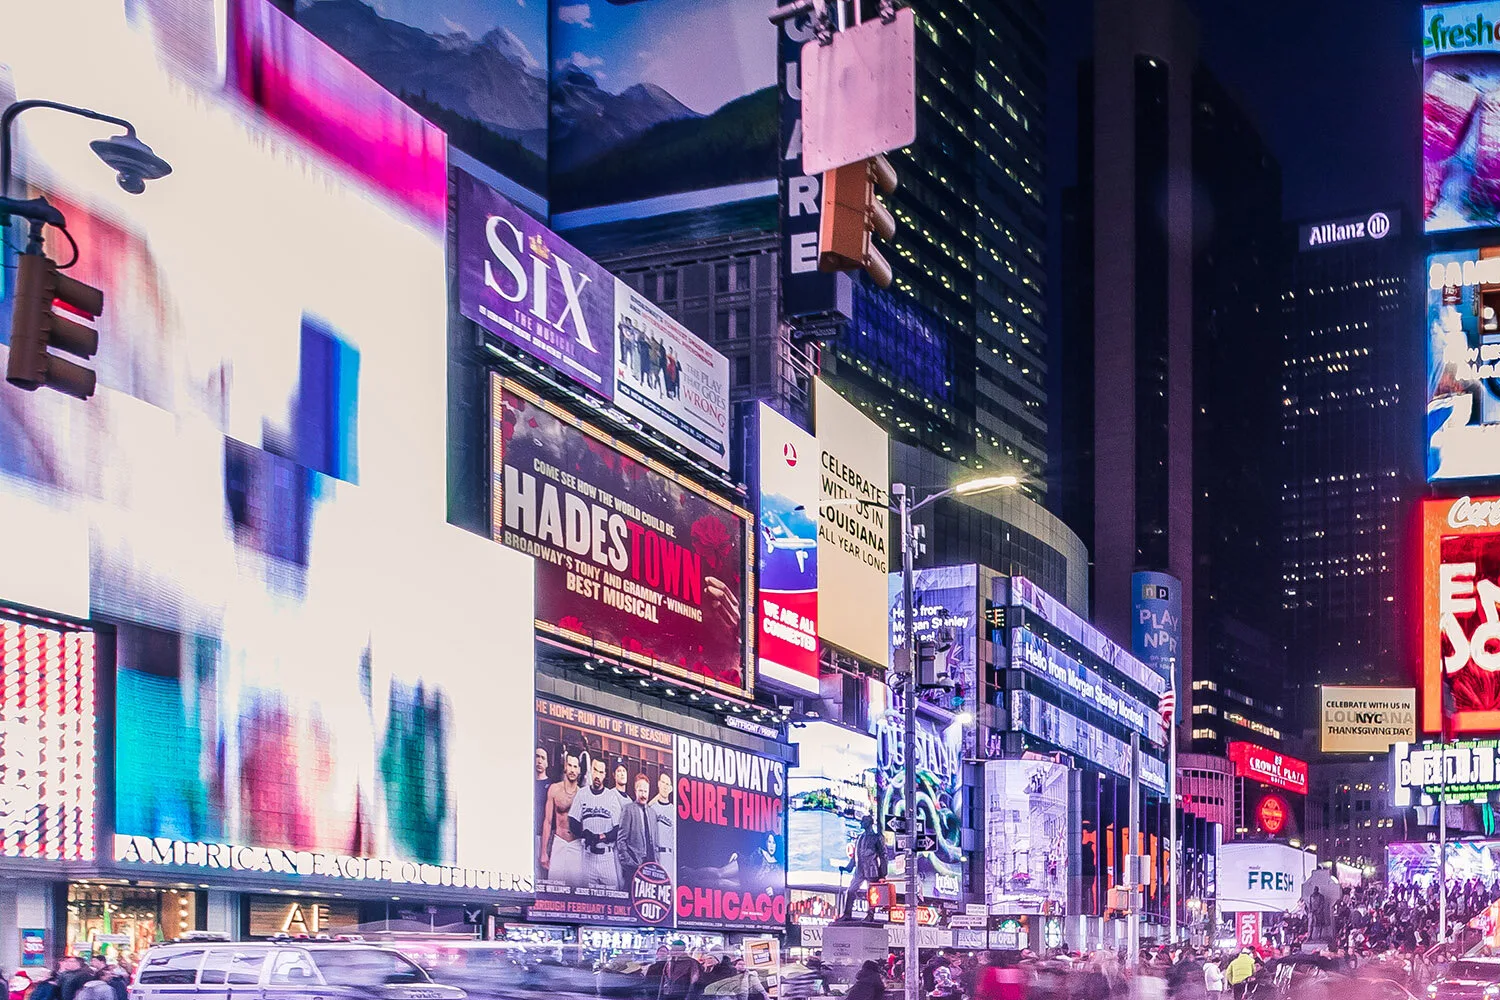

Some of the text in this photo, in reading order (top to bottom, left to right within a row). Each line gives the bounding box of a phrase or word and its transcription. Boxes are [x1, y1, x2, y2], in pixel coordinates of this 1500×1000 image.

[1309, 222, 1365, 246] Allianz
[484, 216, 599, 354] SIX
[683, 385, 727, 428] WRONG
[821, 450, 882, 504] CELEBRATE
[533, 458, 560, 482] COME
[560, 471, 577, 490] SEE
[577, 478, 597, 499] HOW
[598, 488, 614, 508] THE
[614, 497, 641, 521] WORLD
[641, 511, 665, 533] COULD
[504, 464, 702, 606] HADESTOWN
[819, 505, 886, 555] LOUISIANA
[872, 508, 884, 529] IN
[505, 531, 574, 570] BROADWAY'S
[574, 558, 601, 581] TONY
[603, 571, 622, 590] AND
[819, 524, 886, 574] ALL YEAR LONG
[566, 571, 659, 624] BEST MUSICAL
[763, 599, 816, 635] WE ARE ALL
[1139, 608, 1179, 632] PLAY
[1144, 628, 1178, 654] NPR
[1025, 641, 1047, 671] Hello
[1048, 656, 1067, 684] from
[1067, 668, 1095, 699] Morgan
[1095, 686, 1119, 716] Stanley
[536, 699, 548, 714] HE
[596, 715, 612, 730] HIT
[612, 719, 623, 732] OF
[624, 722, 639, 738] THE
[1326, 701, 1411, 710] CELEBRATE WITH US IN
[1355, 713, 1383, 724] NYC
[1327, 725, 1411, 736] THANKSGIVING DAY
[677, 735, 784, 797] BROADWAY'S
[1283, 767, 1305, 784] PLAZA
[677, 777, 783, 836] SURE THING
[312, 852, 393, 880] EAGLE
[1248, 871, 1294, 893] FRESH
[634, 877, 672, 905] TAKE ME
[677, 885, 786, 924] CHICAGO
[280, 901, 330, 933] AE
[641, 902, 662, 920] OUT
[1241, 913, 1256, 945] tkts
